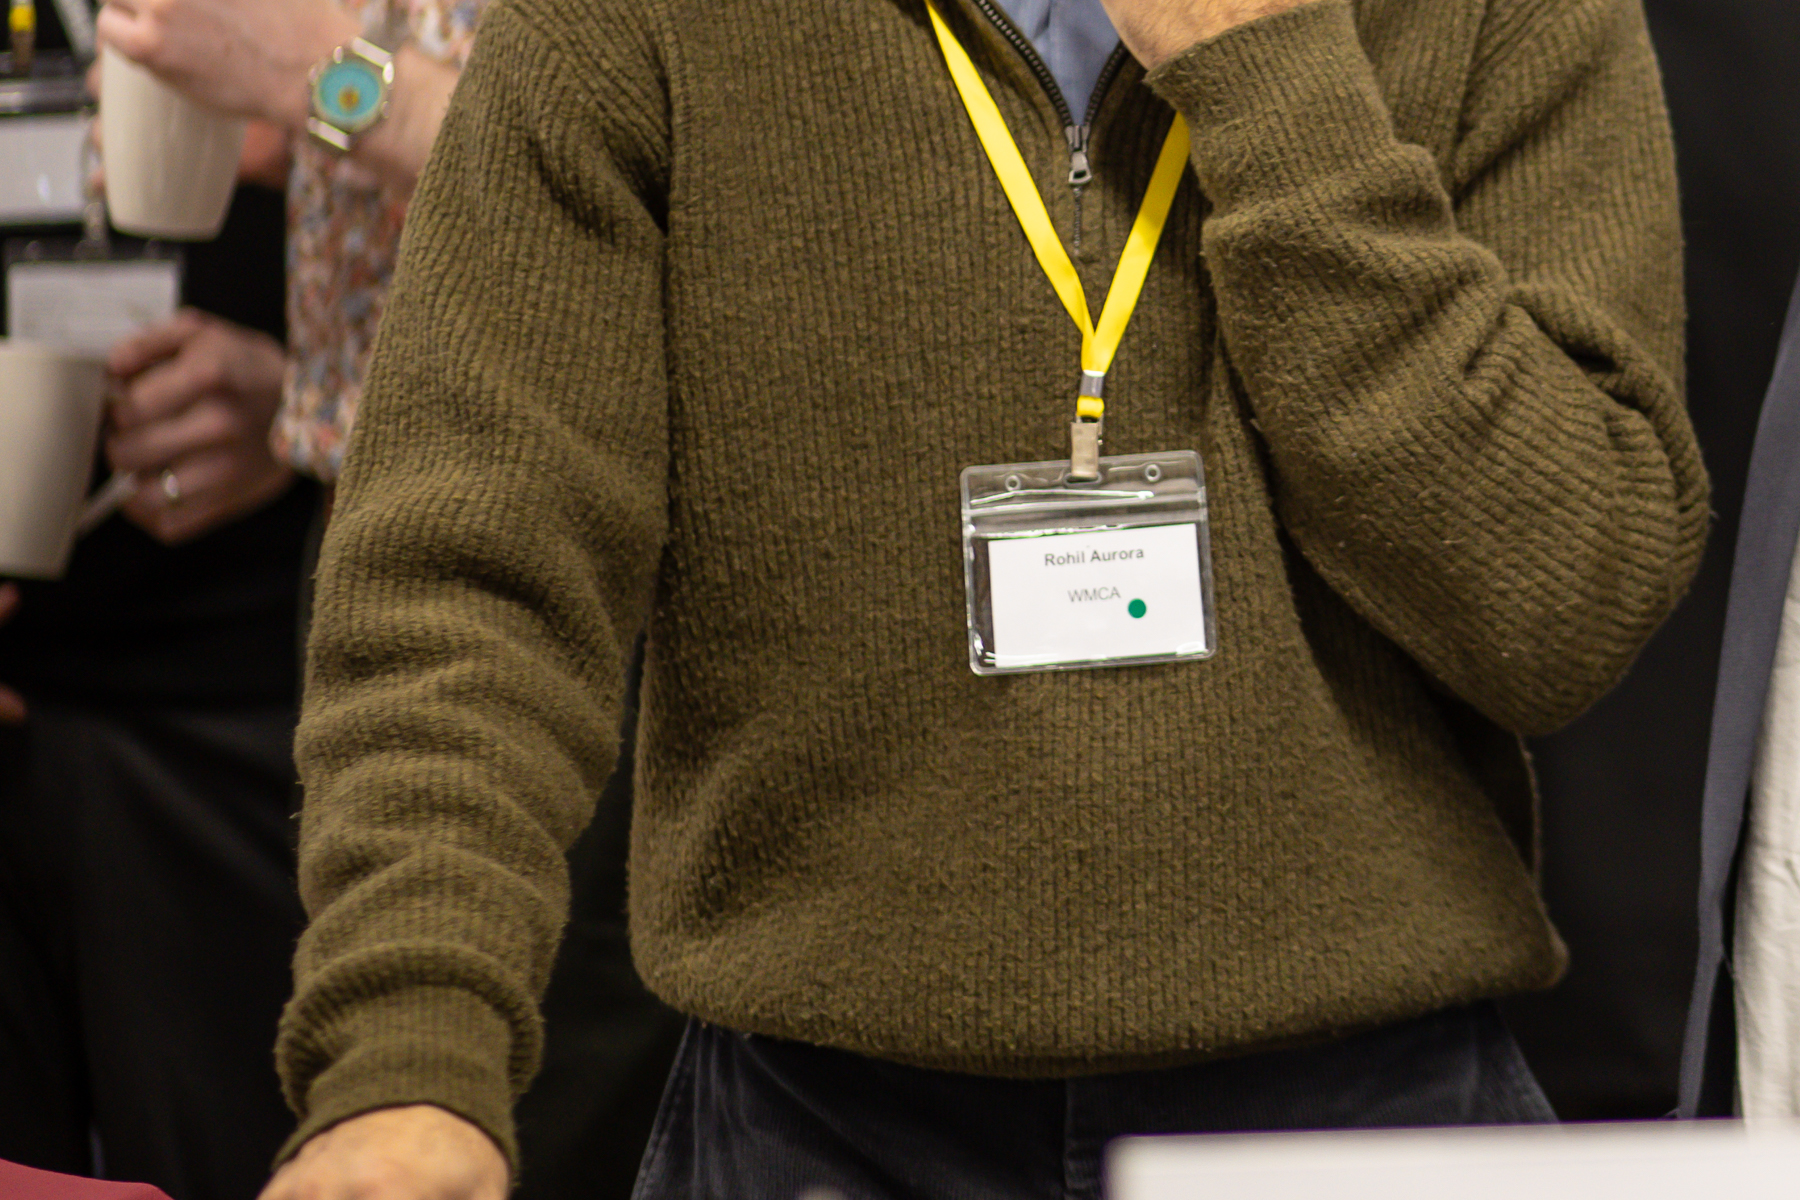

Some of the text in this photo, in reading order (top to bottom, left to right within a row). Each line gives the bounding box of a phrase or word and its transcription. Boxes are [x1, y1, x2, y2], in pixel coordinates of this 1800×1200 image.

[1044, 549, 1144, 566] Rohil Aurora
[1067, 586, 1121, 602] WMCA
